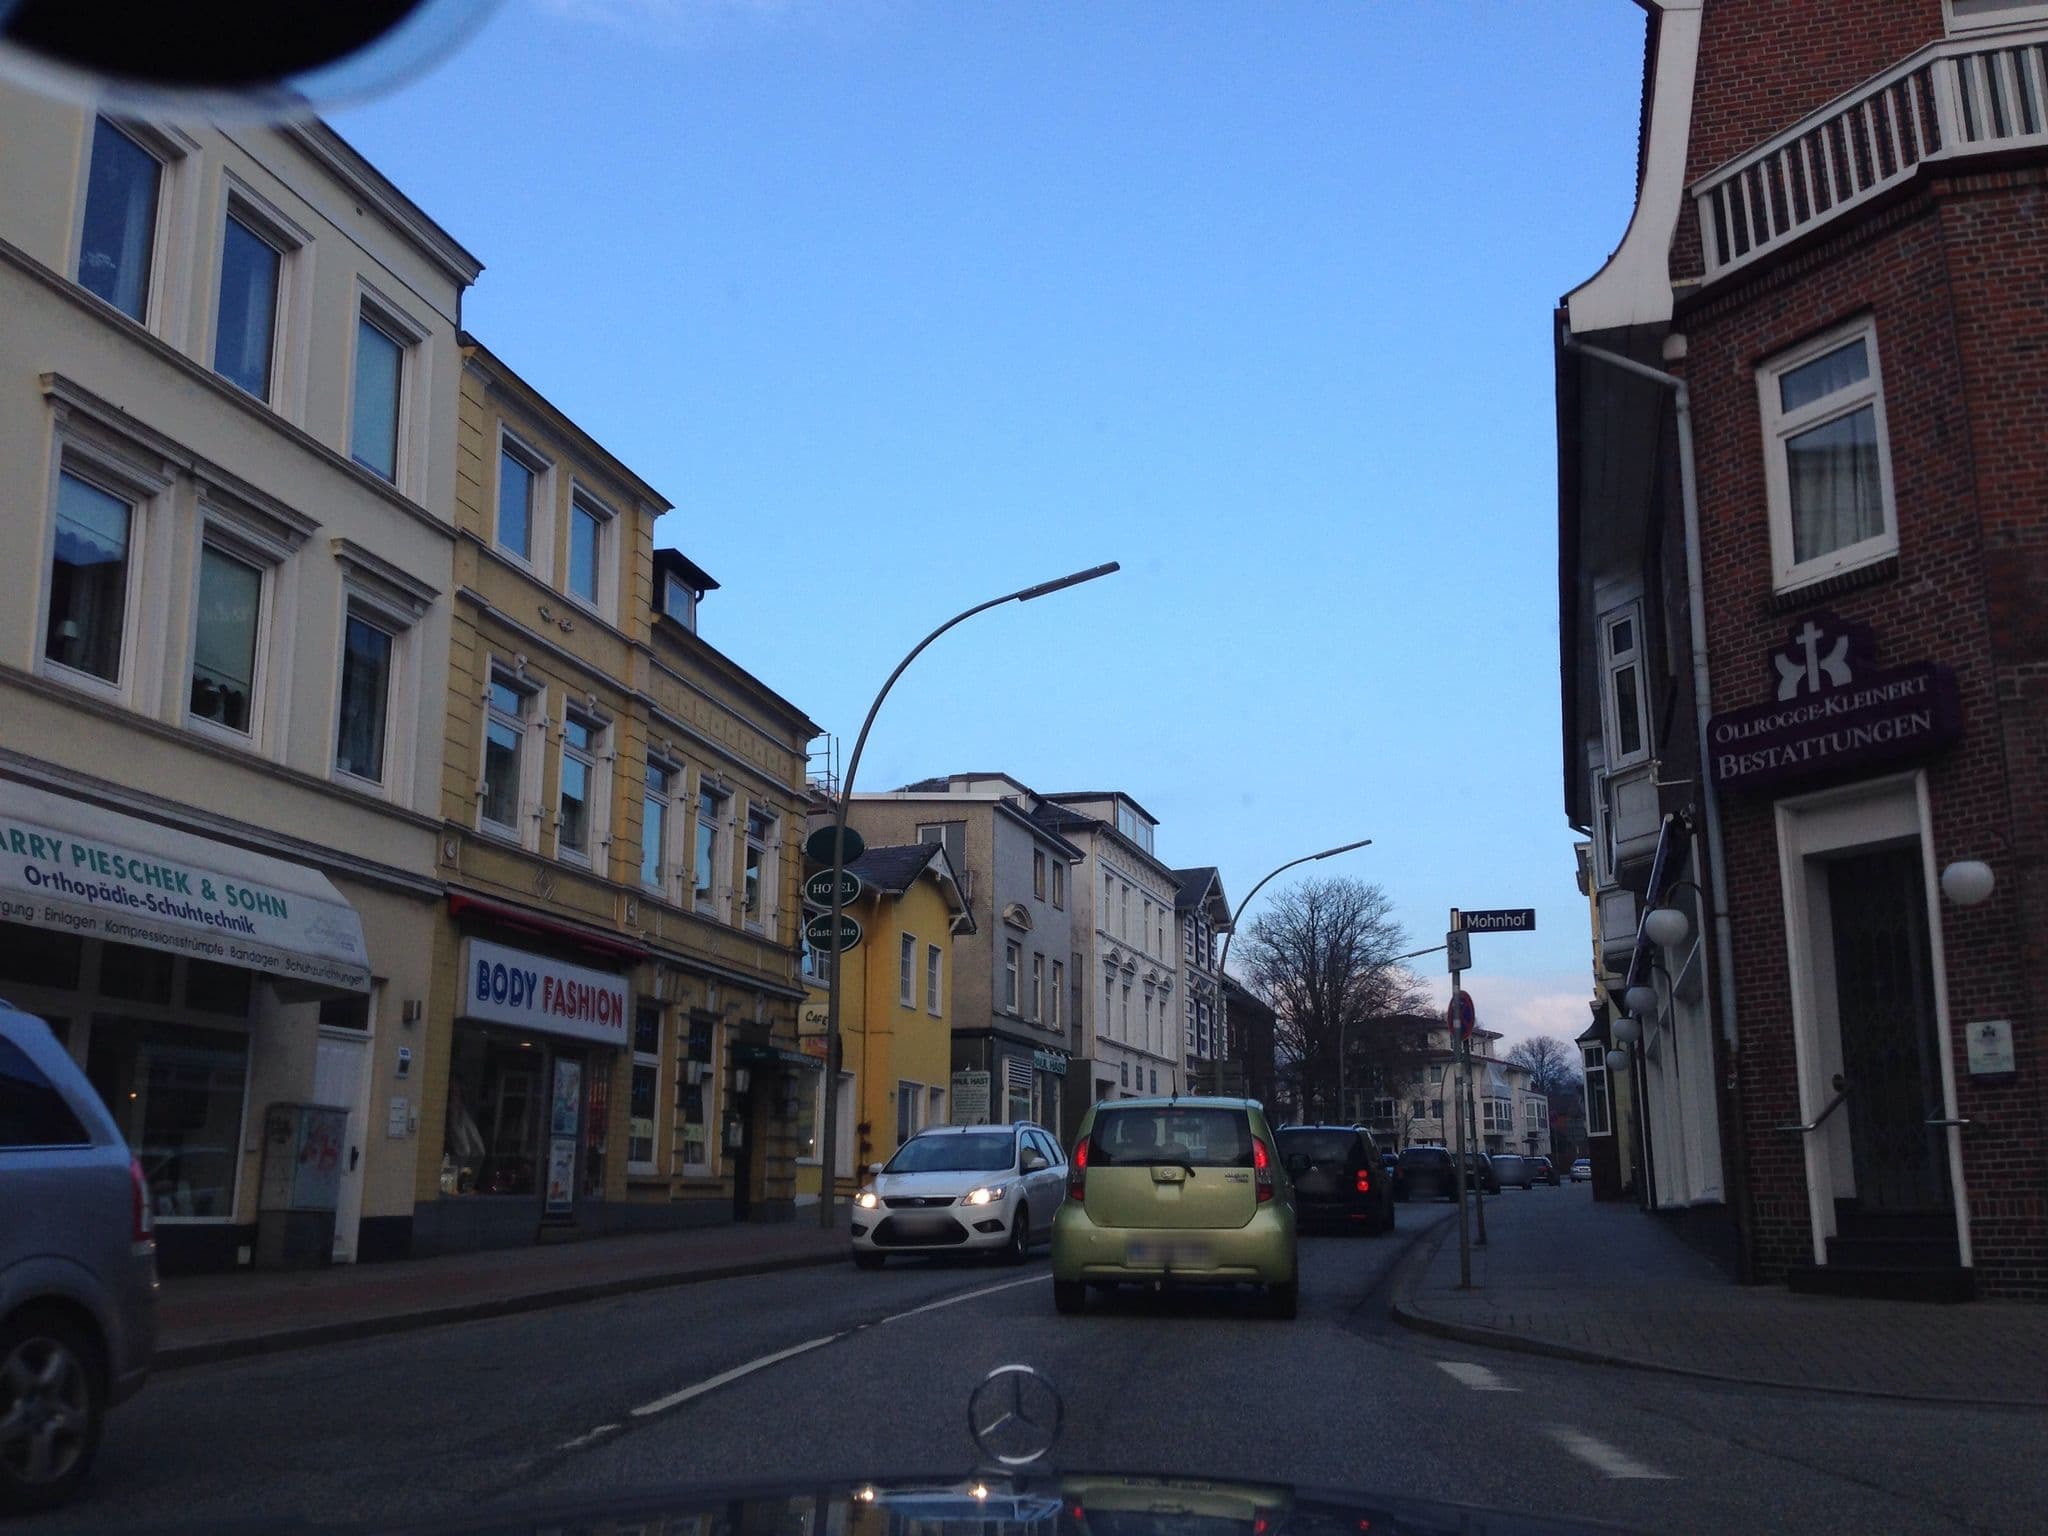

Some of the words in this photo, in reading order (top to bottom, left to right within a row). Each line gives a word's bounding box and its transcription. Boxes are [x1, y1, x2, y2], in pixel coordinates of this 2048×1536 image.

[1718, 710, 1932, 781] BESTATTUNGEN
[24, 865, 257, 935] Orthopädie-Schuhtechnik
[72, 843, 192, 896] PIESCHEK
[201, 878, 217, 901] &
[225, 883, 288, 920] SOHN
[813, 882, 855, 894] HOEL
[45, 907, 96, 929] Einlagen
[105, 919, 225, 957] Kompressionsstrümpfe
[230, 945, 280, 968] Bandagen
[808, 927, 857, 938] Gastsätte
[1466, 912, 1527, 929] Mohnhof
[476, 959, 537, 1010] BODY
[542, 975, 624, 1029] FASHION
